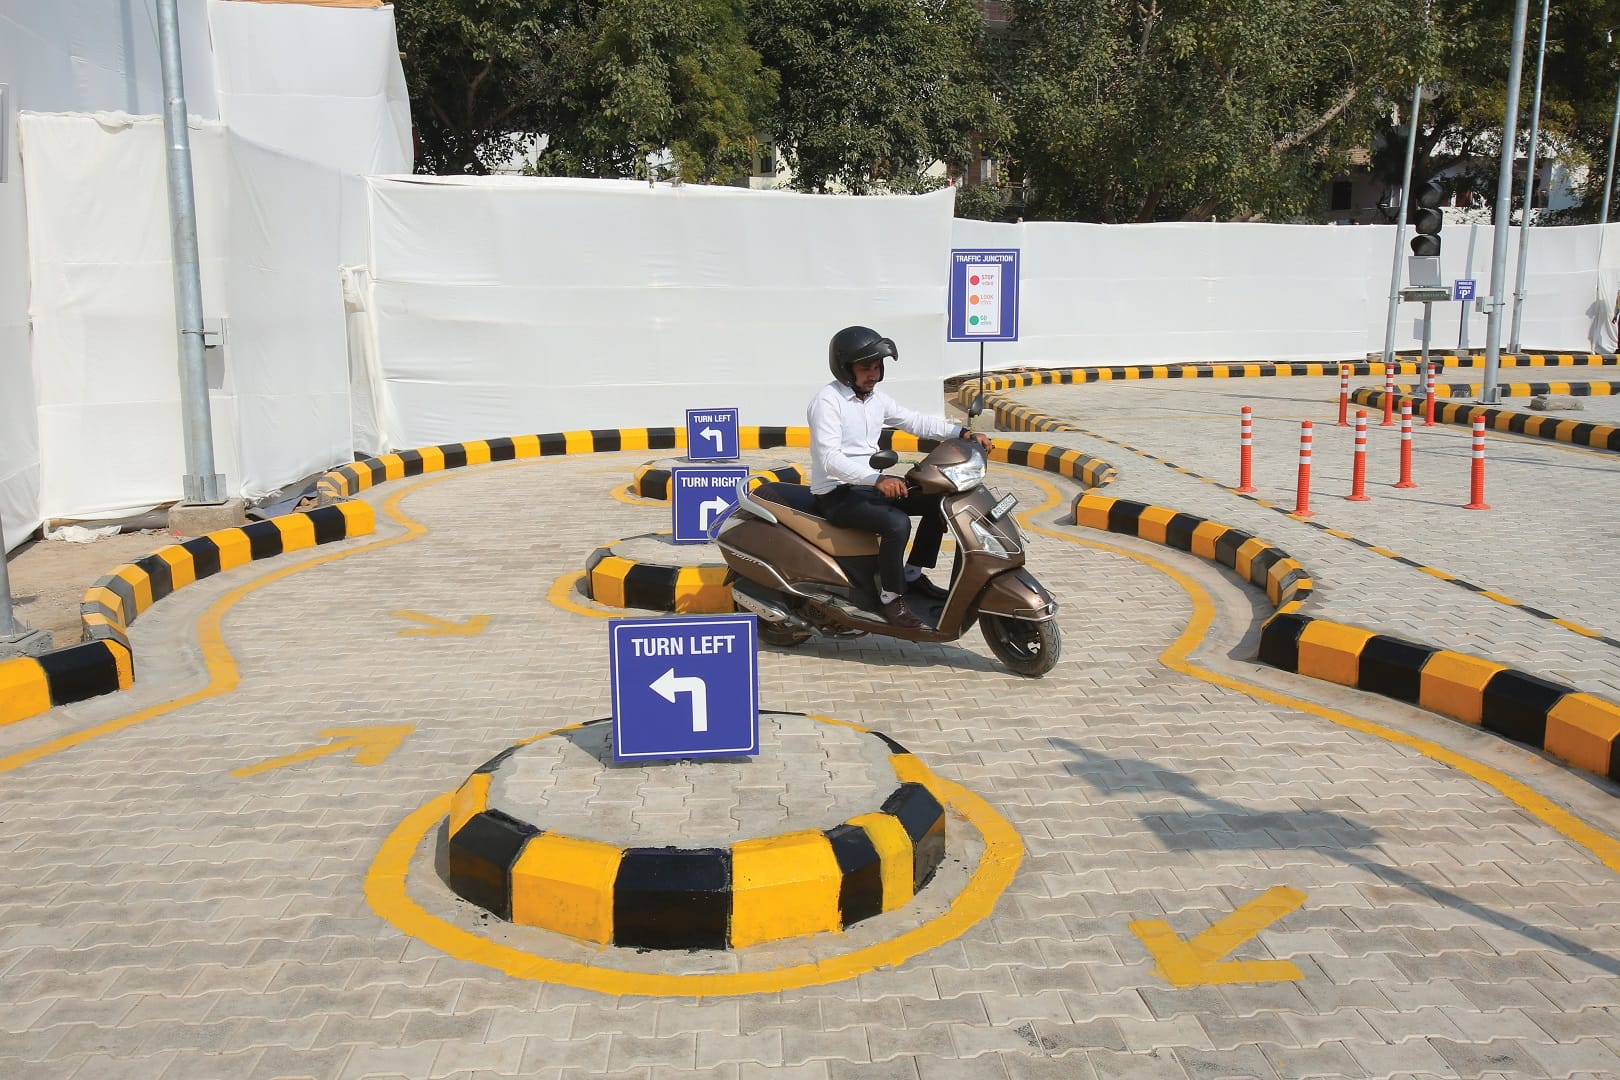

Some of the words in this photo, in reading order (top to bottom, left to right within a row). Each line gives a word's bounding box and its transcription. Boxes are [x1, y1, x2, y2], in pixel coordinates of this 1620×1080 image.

[693, 415, 713, 423] TURN
[714, 414, 732, 422] LEFT
[680, 477, 708, 488] TURN
[711, 476, 742, 488] RIGHT
[631, 637, 683, 657] TURN
[690, 635, 736, 655] LEFT
